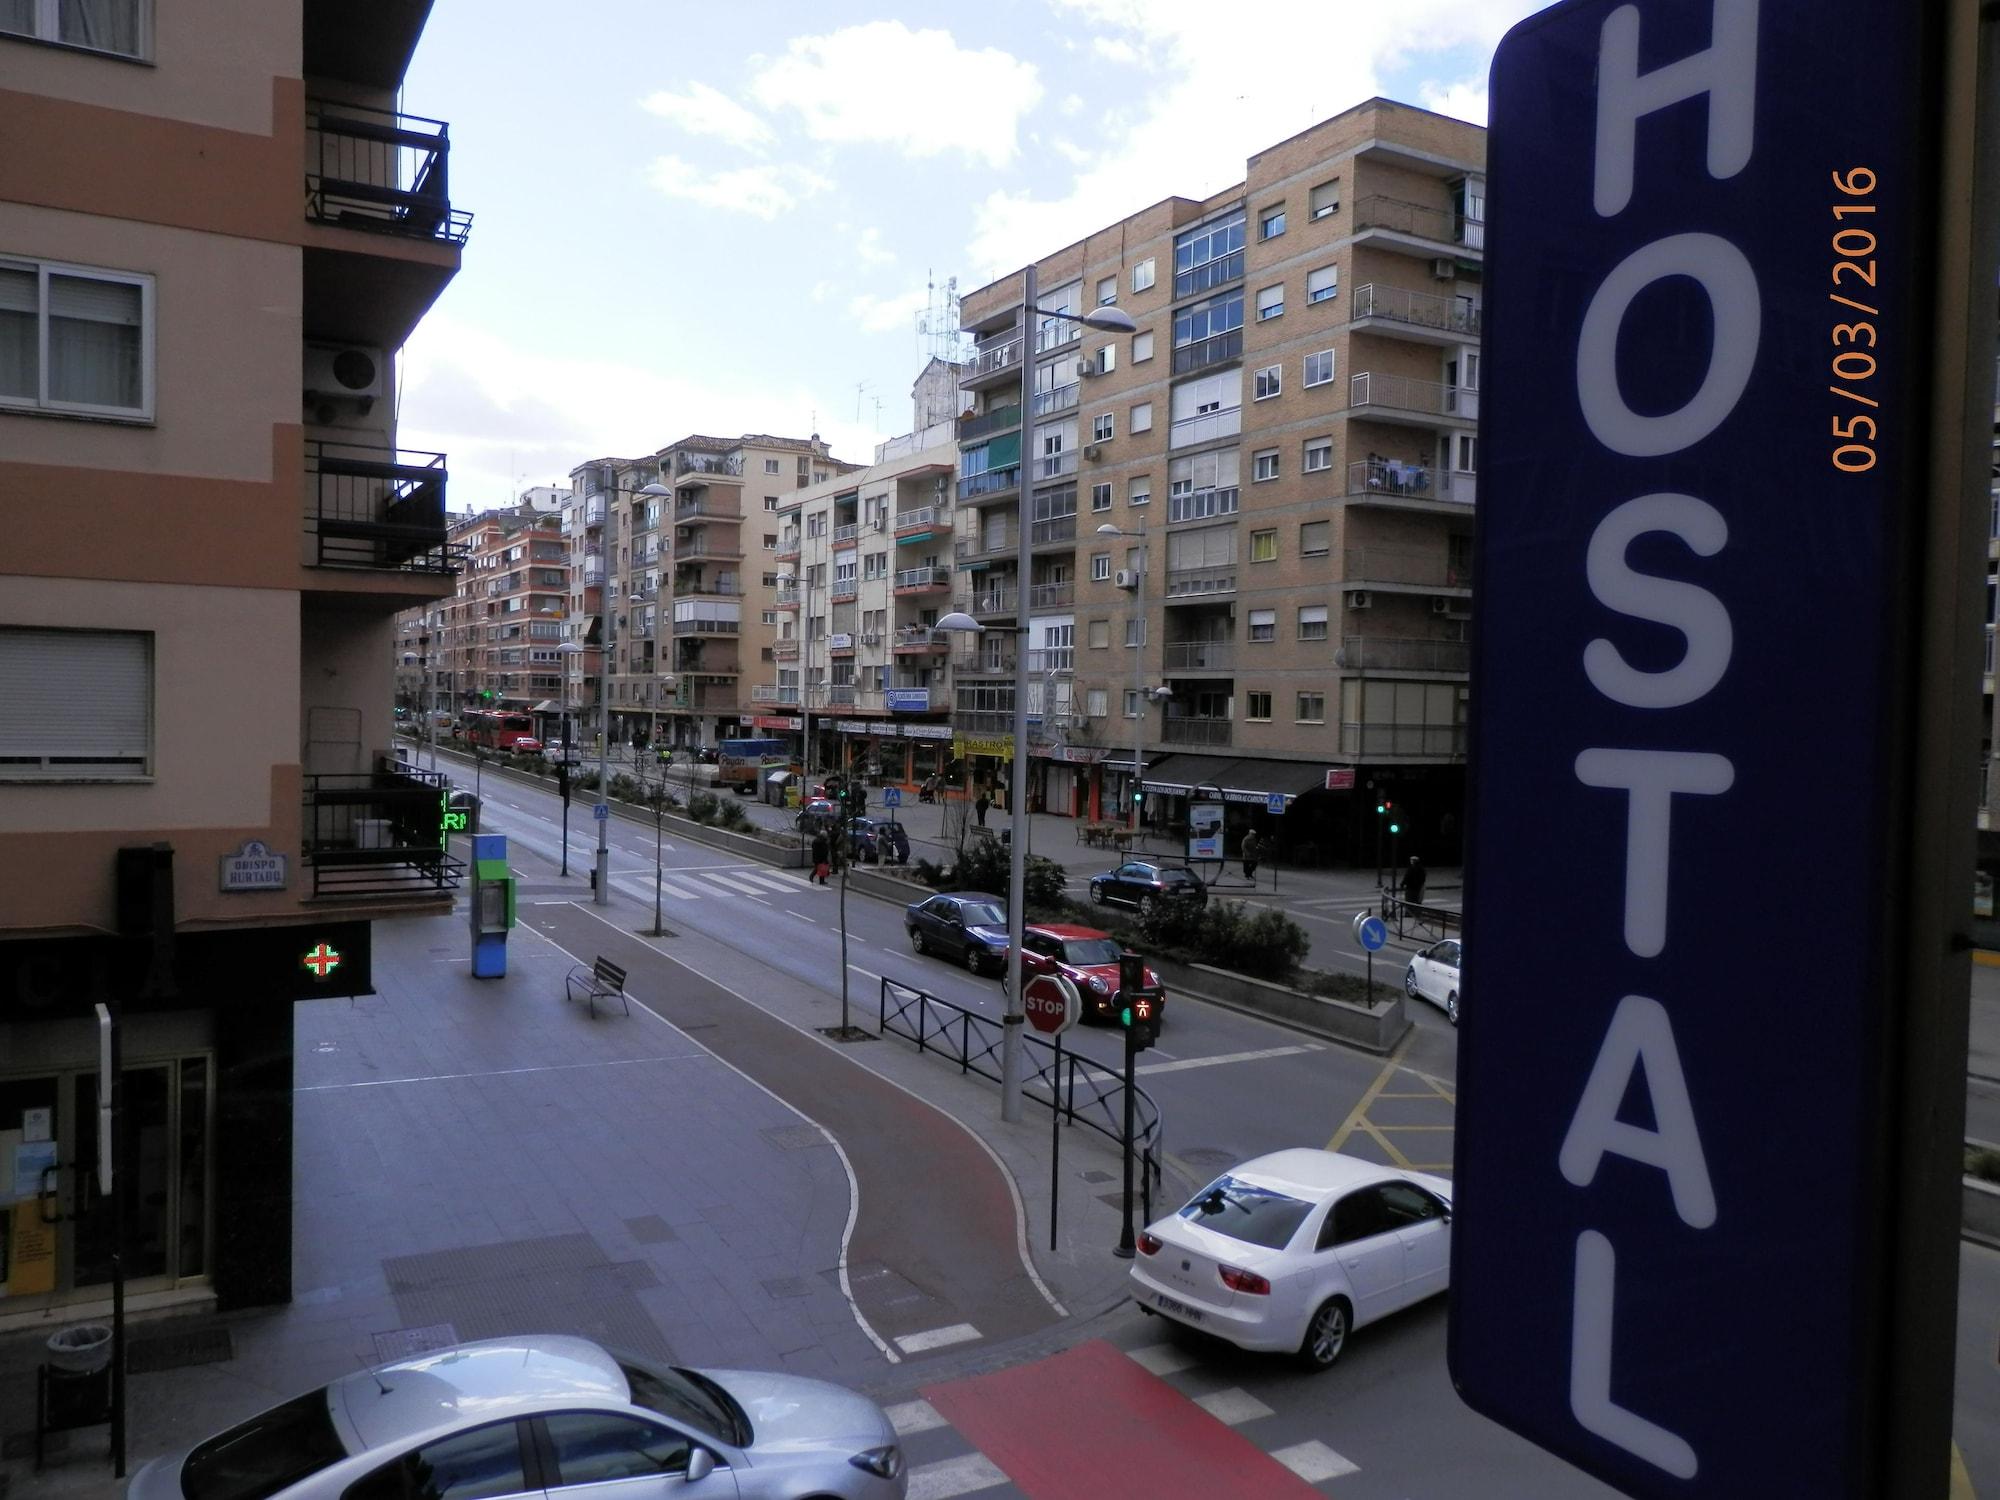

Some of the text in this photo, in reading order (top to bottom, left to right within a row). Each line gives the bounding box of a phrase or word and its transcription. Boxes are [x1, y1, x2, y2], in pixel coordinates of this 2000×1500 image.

[1557, 0, 1763, 1480] HOSTAL
[234, 860, 276, 870] OBISPO
[229, 871, 281, 884] HURTADO
[1026, 996, 1065, 1016] STOP
